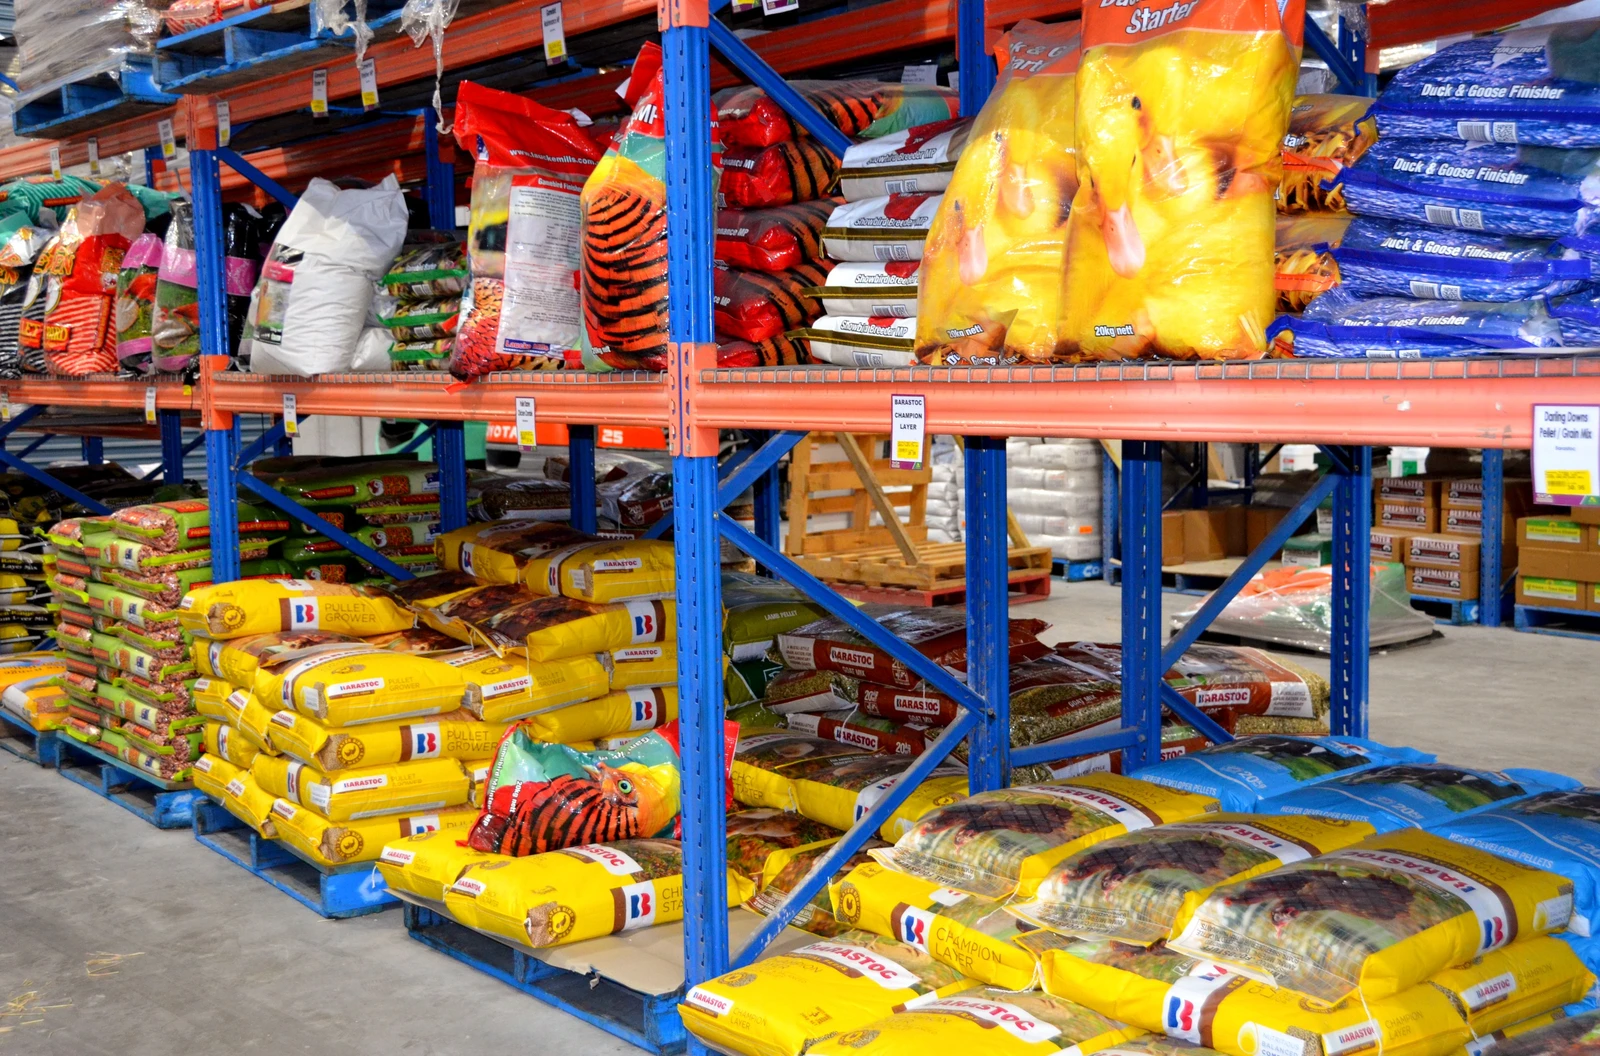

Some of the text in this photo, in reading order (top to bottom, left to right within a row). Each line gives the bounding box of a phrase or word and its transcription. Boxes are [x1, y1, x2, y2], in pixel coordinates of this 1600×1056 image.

[1421, 84, 1565, 100] Duck & Goose Finisher
[923, 148, 937, 159] MP
[1393, 157, 1528, 185] Duck & Goose Finisher
[854, 216, 887, 227] Showbird
[912, 216, 928, 227] MP
[1412, 239, 1422, 252] &
[1424, 241, 1461, 257] Goose
[855, 273, 888, 285] Showbird
[1418, 314, 1470, 326] Finisher
[840, 320, 909, 337] Showbird Breeder MP
[1094, 325, 1134, 337] 20kg nett
[894, 398, 922, 406] BARASTOC
[1544, 411, 1588, 424] Darling Downs
[602, 428, 624, 443] 25
[1540, 427, 1556, 438] Pellet
[1562, 428, 1579, 439] Grain
[1580, 428, 1592, 439] Mix
[1382, 477, 1424, 489] BEEFMASTER
[1450, 481, 1482, 492] BEEFMAS
[1384, 504, 1425, 515] BEEFMASTER
[1449, 509, 1482, 520] BEEFMAS
[1371, 535, 1392, 545] ASTER
[1412, 539, 1460, 551] BEEFMASTER
[603, 559, 638, 568] BARASTOC
[1414, 568, 1460, 580] BEEFMASTER
[324, 603, 366, 613] PULLET
[325, 612, 377, 623] GROWER
[764, 610, 798, 621] LAMB PELLET
[624, 649, 659, 657] BARASTOC
[831, 649, 872, 666] BARASTOC
[339, 679, 379, 692] BARASTOC
[493, 679, 530, 692] BARASTOC
[1198, 691, 1248, 704] BARASTOC
[896, 698, 939, 711] BARASTOC
[447, 730, 489, 741] PULLET
[836, 727, 877, 748] BARASTOC
[447, 741, 498, 753] GROWER
[343, 777, 382, 789] BARASTOC
[1142, 773, 1217, 796] HEIFER DEVELOPER PELLETS
[1280, 805, 1369, 822] HEIFER DEVELOPER PELLETS
[483, 814, 494, 827] MP
[1448, 832, 1475, 846] HEIFER
[1476, 838, 1518, 859] DEVELOPER
[1518, 850, 1554, 869] PELLETS
[936, 926, 1002, 964] CHAMPION
[935, 942, 974, 970] LAYER
[1476, 977, 1511, 1000] BARASTOC
[693, 991, 728, 1011] BARASTOC
[733, 1007, 767, 1027] CHAMPION
[1384, 1010, 1423, 1029] CHAMPION
[1388, 1025, 1412, 1041] LAYER
[1262, 1032, 1300, 1049] NUTRITIOUS
